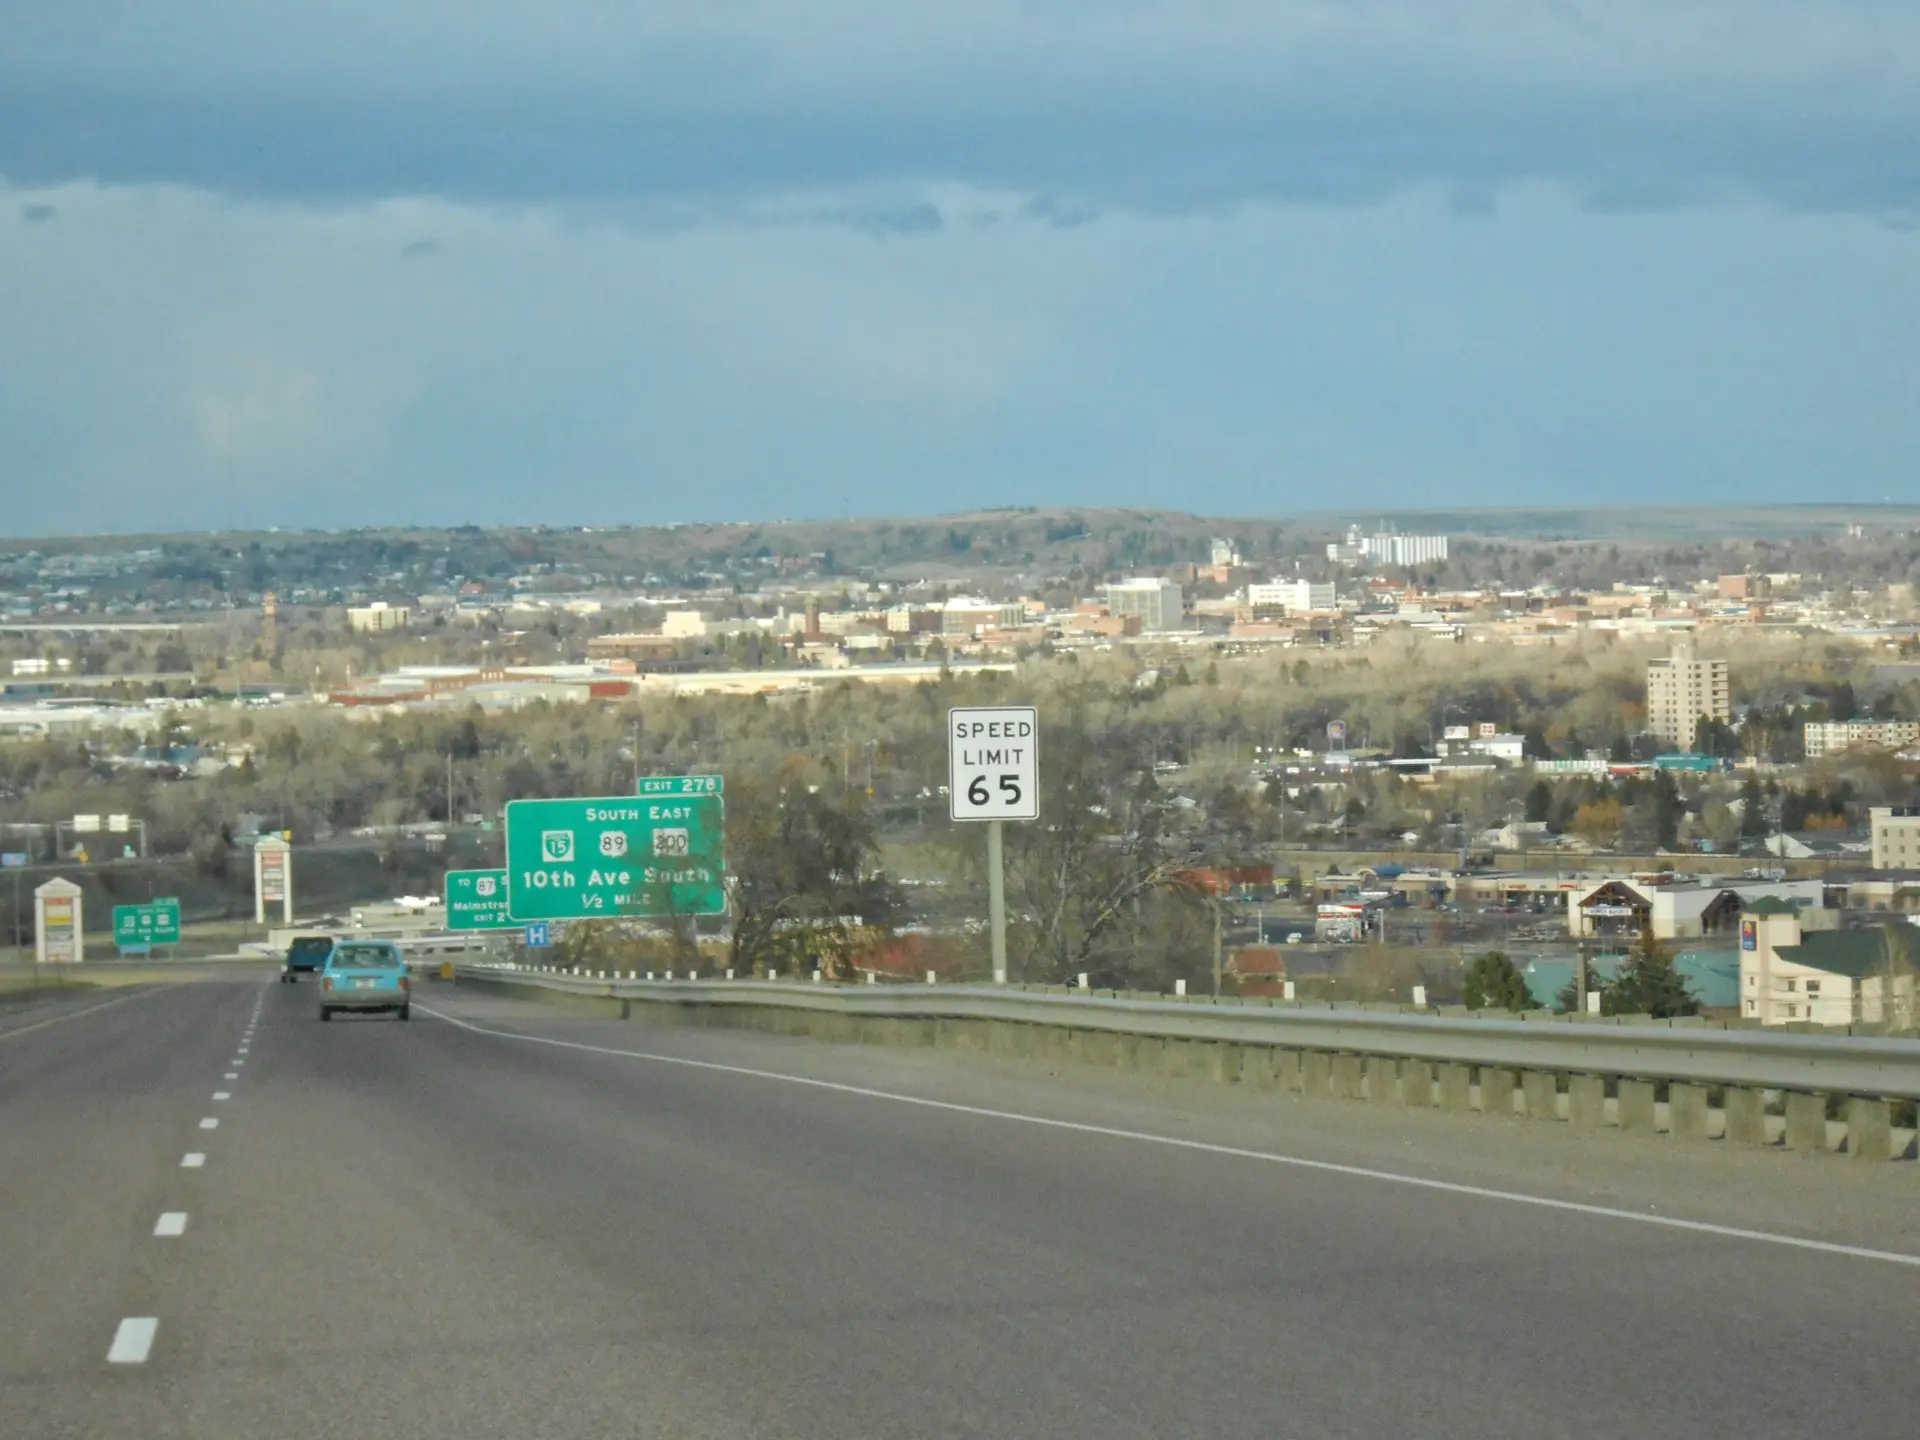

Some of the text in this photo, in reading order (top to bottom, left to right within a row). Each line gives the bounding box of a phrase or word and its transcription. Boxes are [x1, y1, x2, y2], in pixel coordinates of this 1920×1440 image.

[956, 722, 1031, 738] SPEED
[963, 749, 1024, 765] LIMIT
[644, 778, 716, 792] EXIT 278
[968, 774, 1022, 806] 65
[586, 806, 692, 822] SOUTH EAST
[550, 840, 567, 854] 15
[602, 836, 625, 851] 89
[523, 870, 576, 888] 10th
[588, 868, 631, 887] Ave
